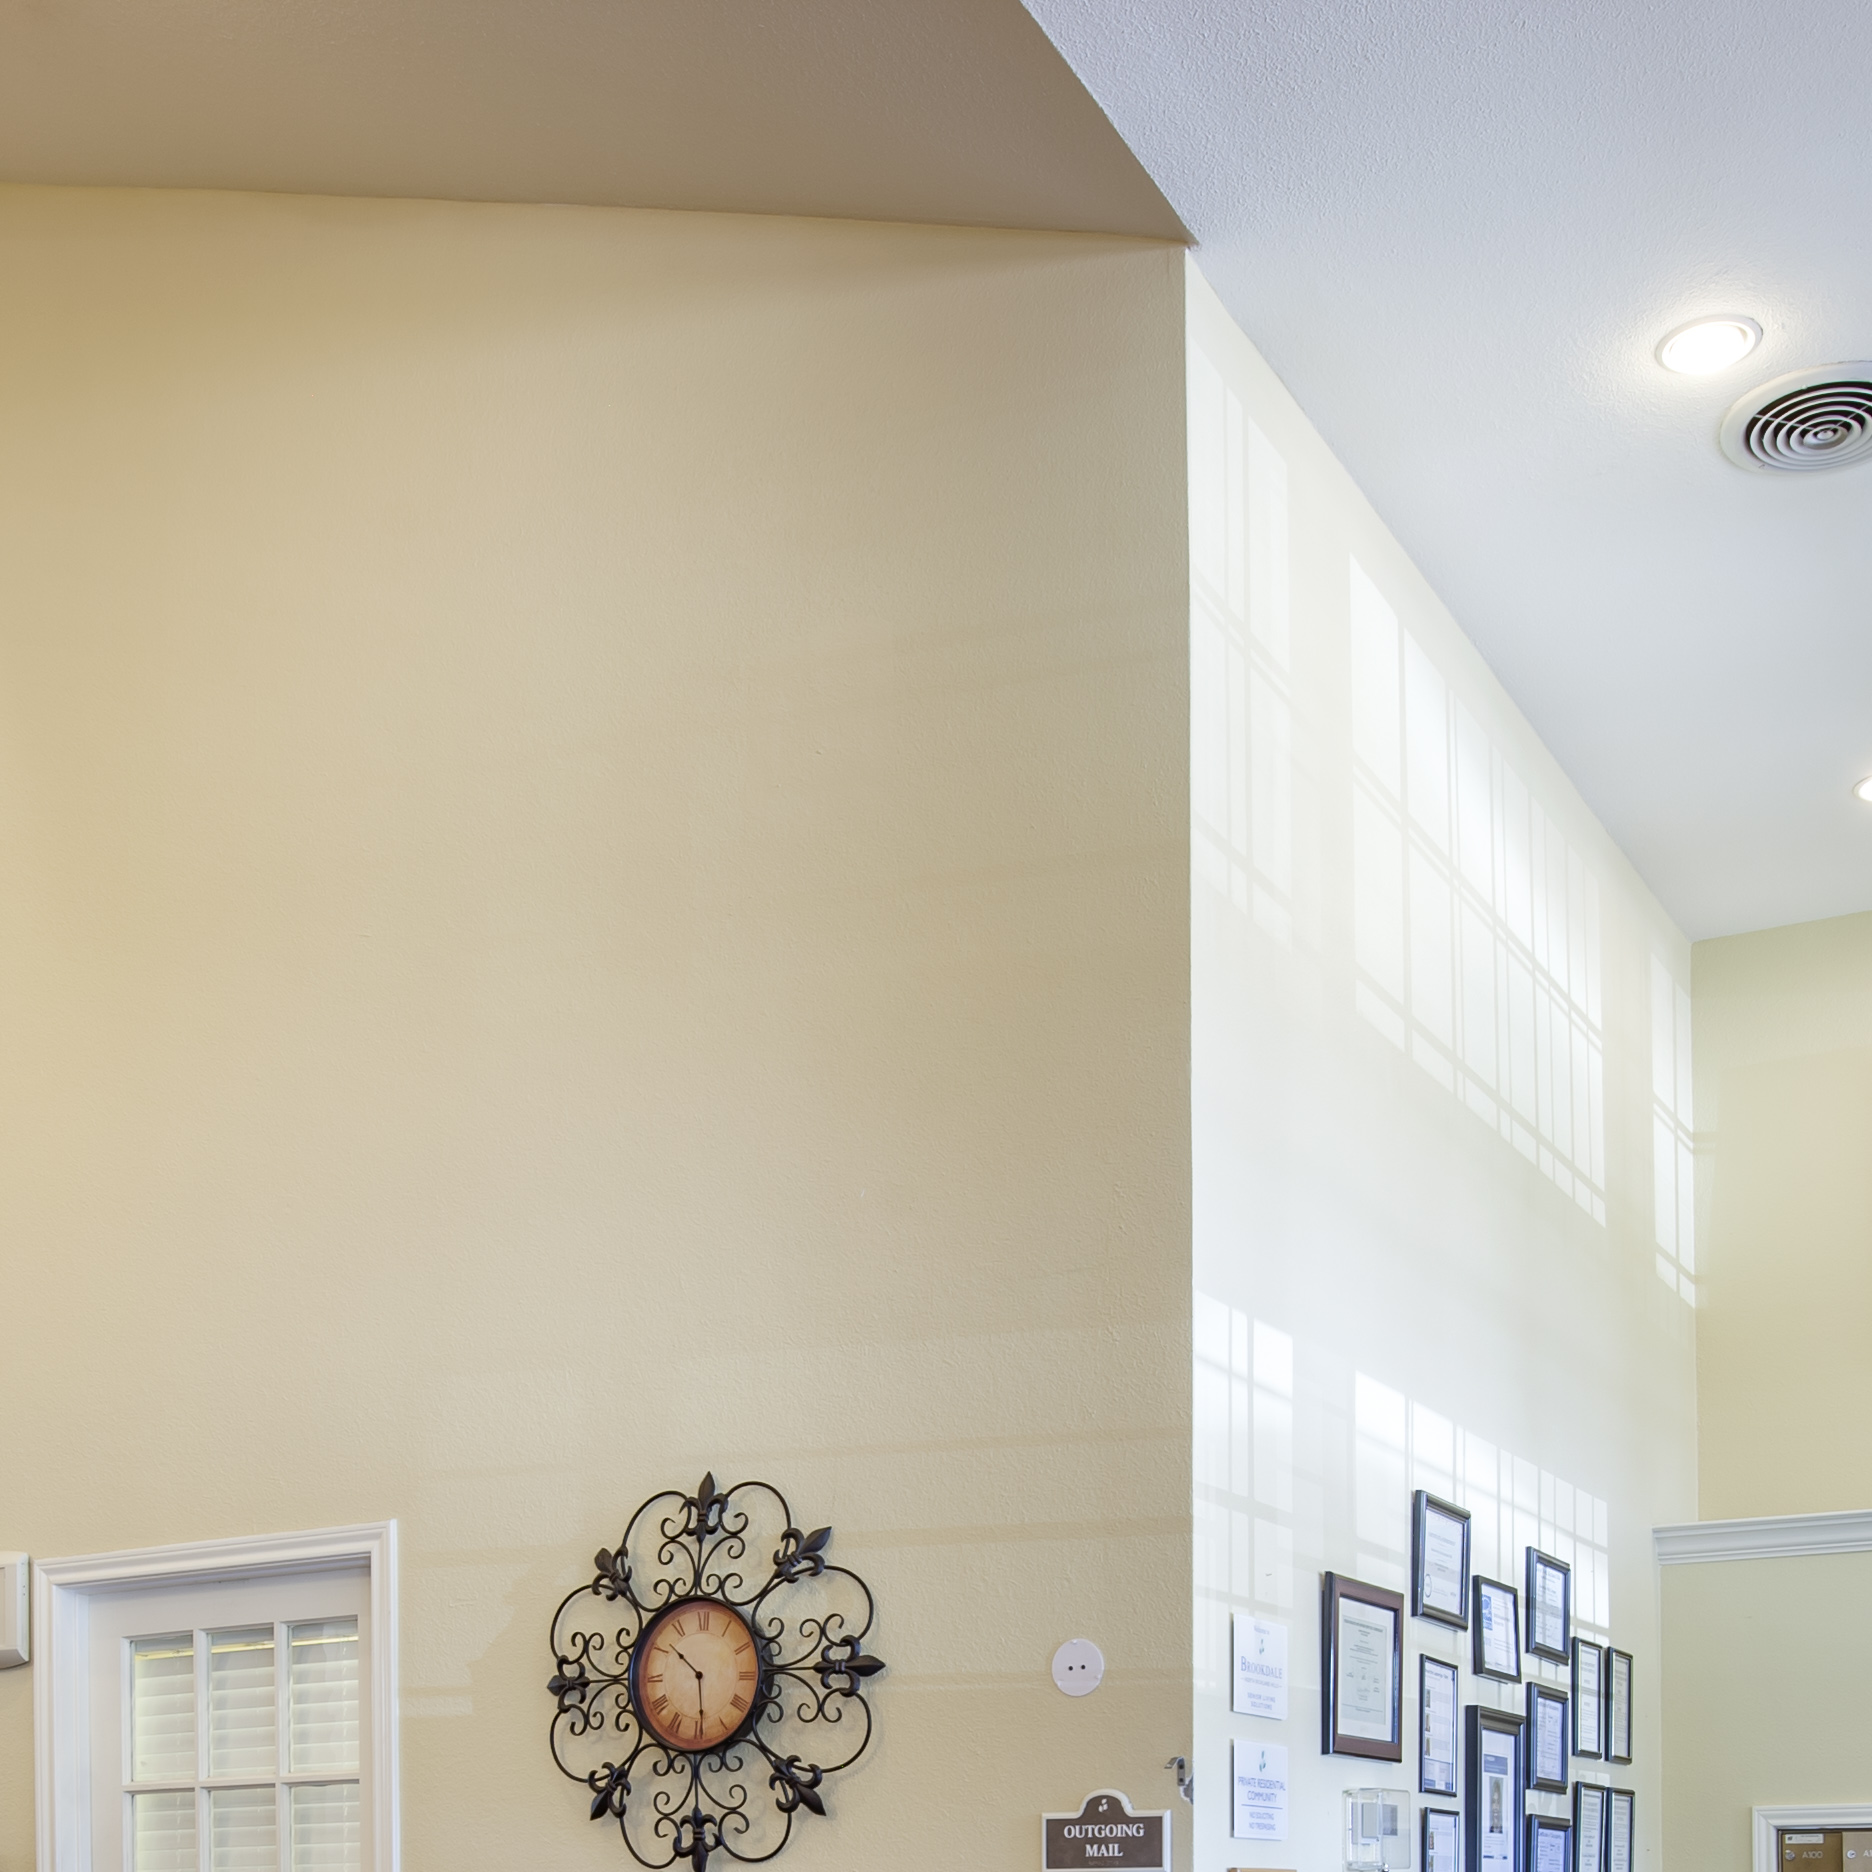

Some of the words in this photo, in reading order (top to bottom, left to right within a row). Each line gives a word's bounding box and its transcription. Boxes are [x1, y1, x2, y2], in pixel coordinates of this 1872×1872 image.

[1240, 1655, 1283, 1679] BROOKDALE
[1063, 1823, 1145, 1839] OUTGOING
[1085, 1843, 1124, 1857] MAIL
[1801, 1850, 1824, 1859] A100
